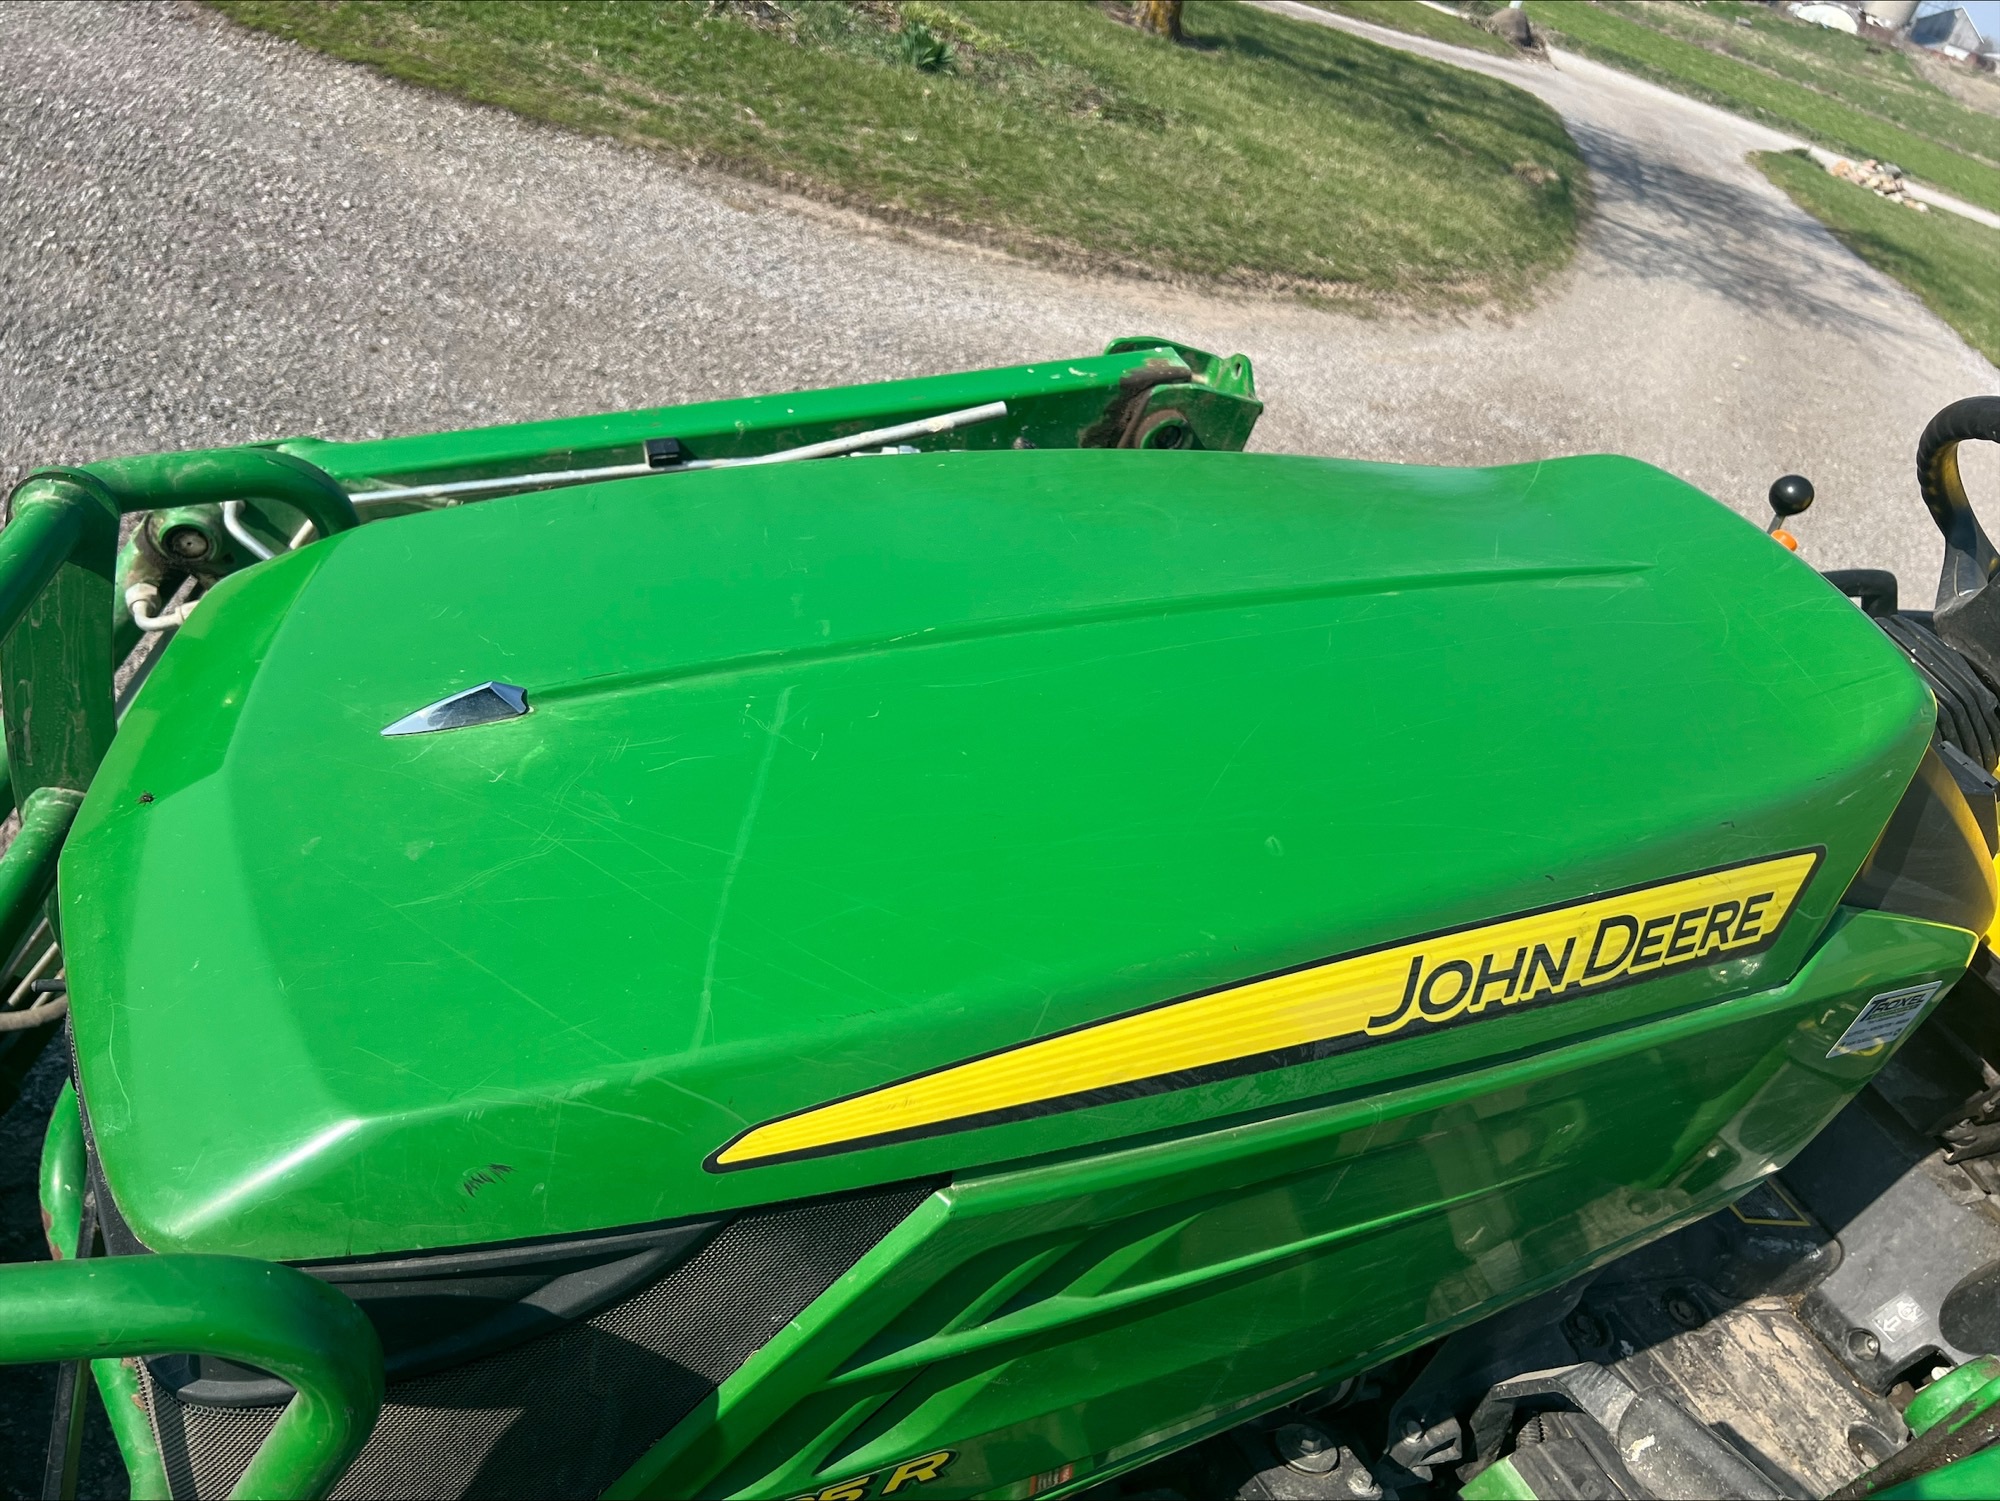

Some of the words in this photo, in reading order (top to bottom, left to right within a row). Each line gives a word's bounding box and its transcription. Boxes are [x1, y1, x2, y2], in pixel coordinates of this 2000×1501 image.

[1368, 936, 1577, 1030] JOHN
[1582, 891, 1775, 982] DEERE
[1859, 993, 1926, 1023] TROXEL
